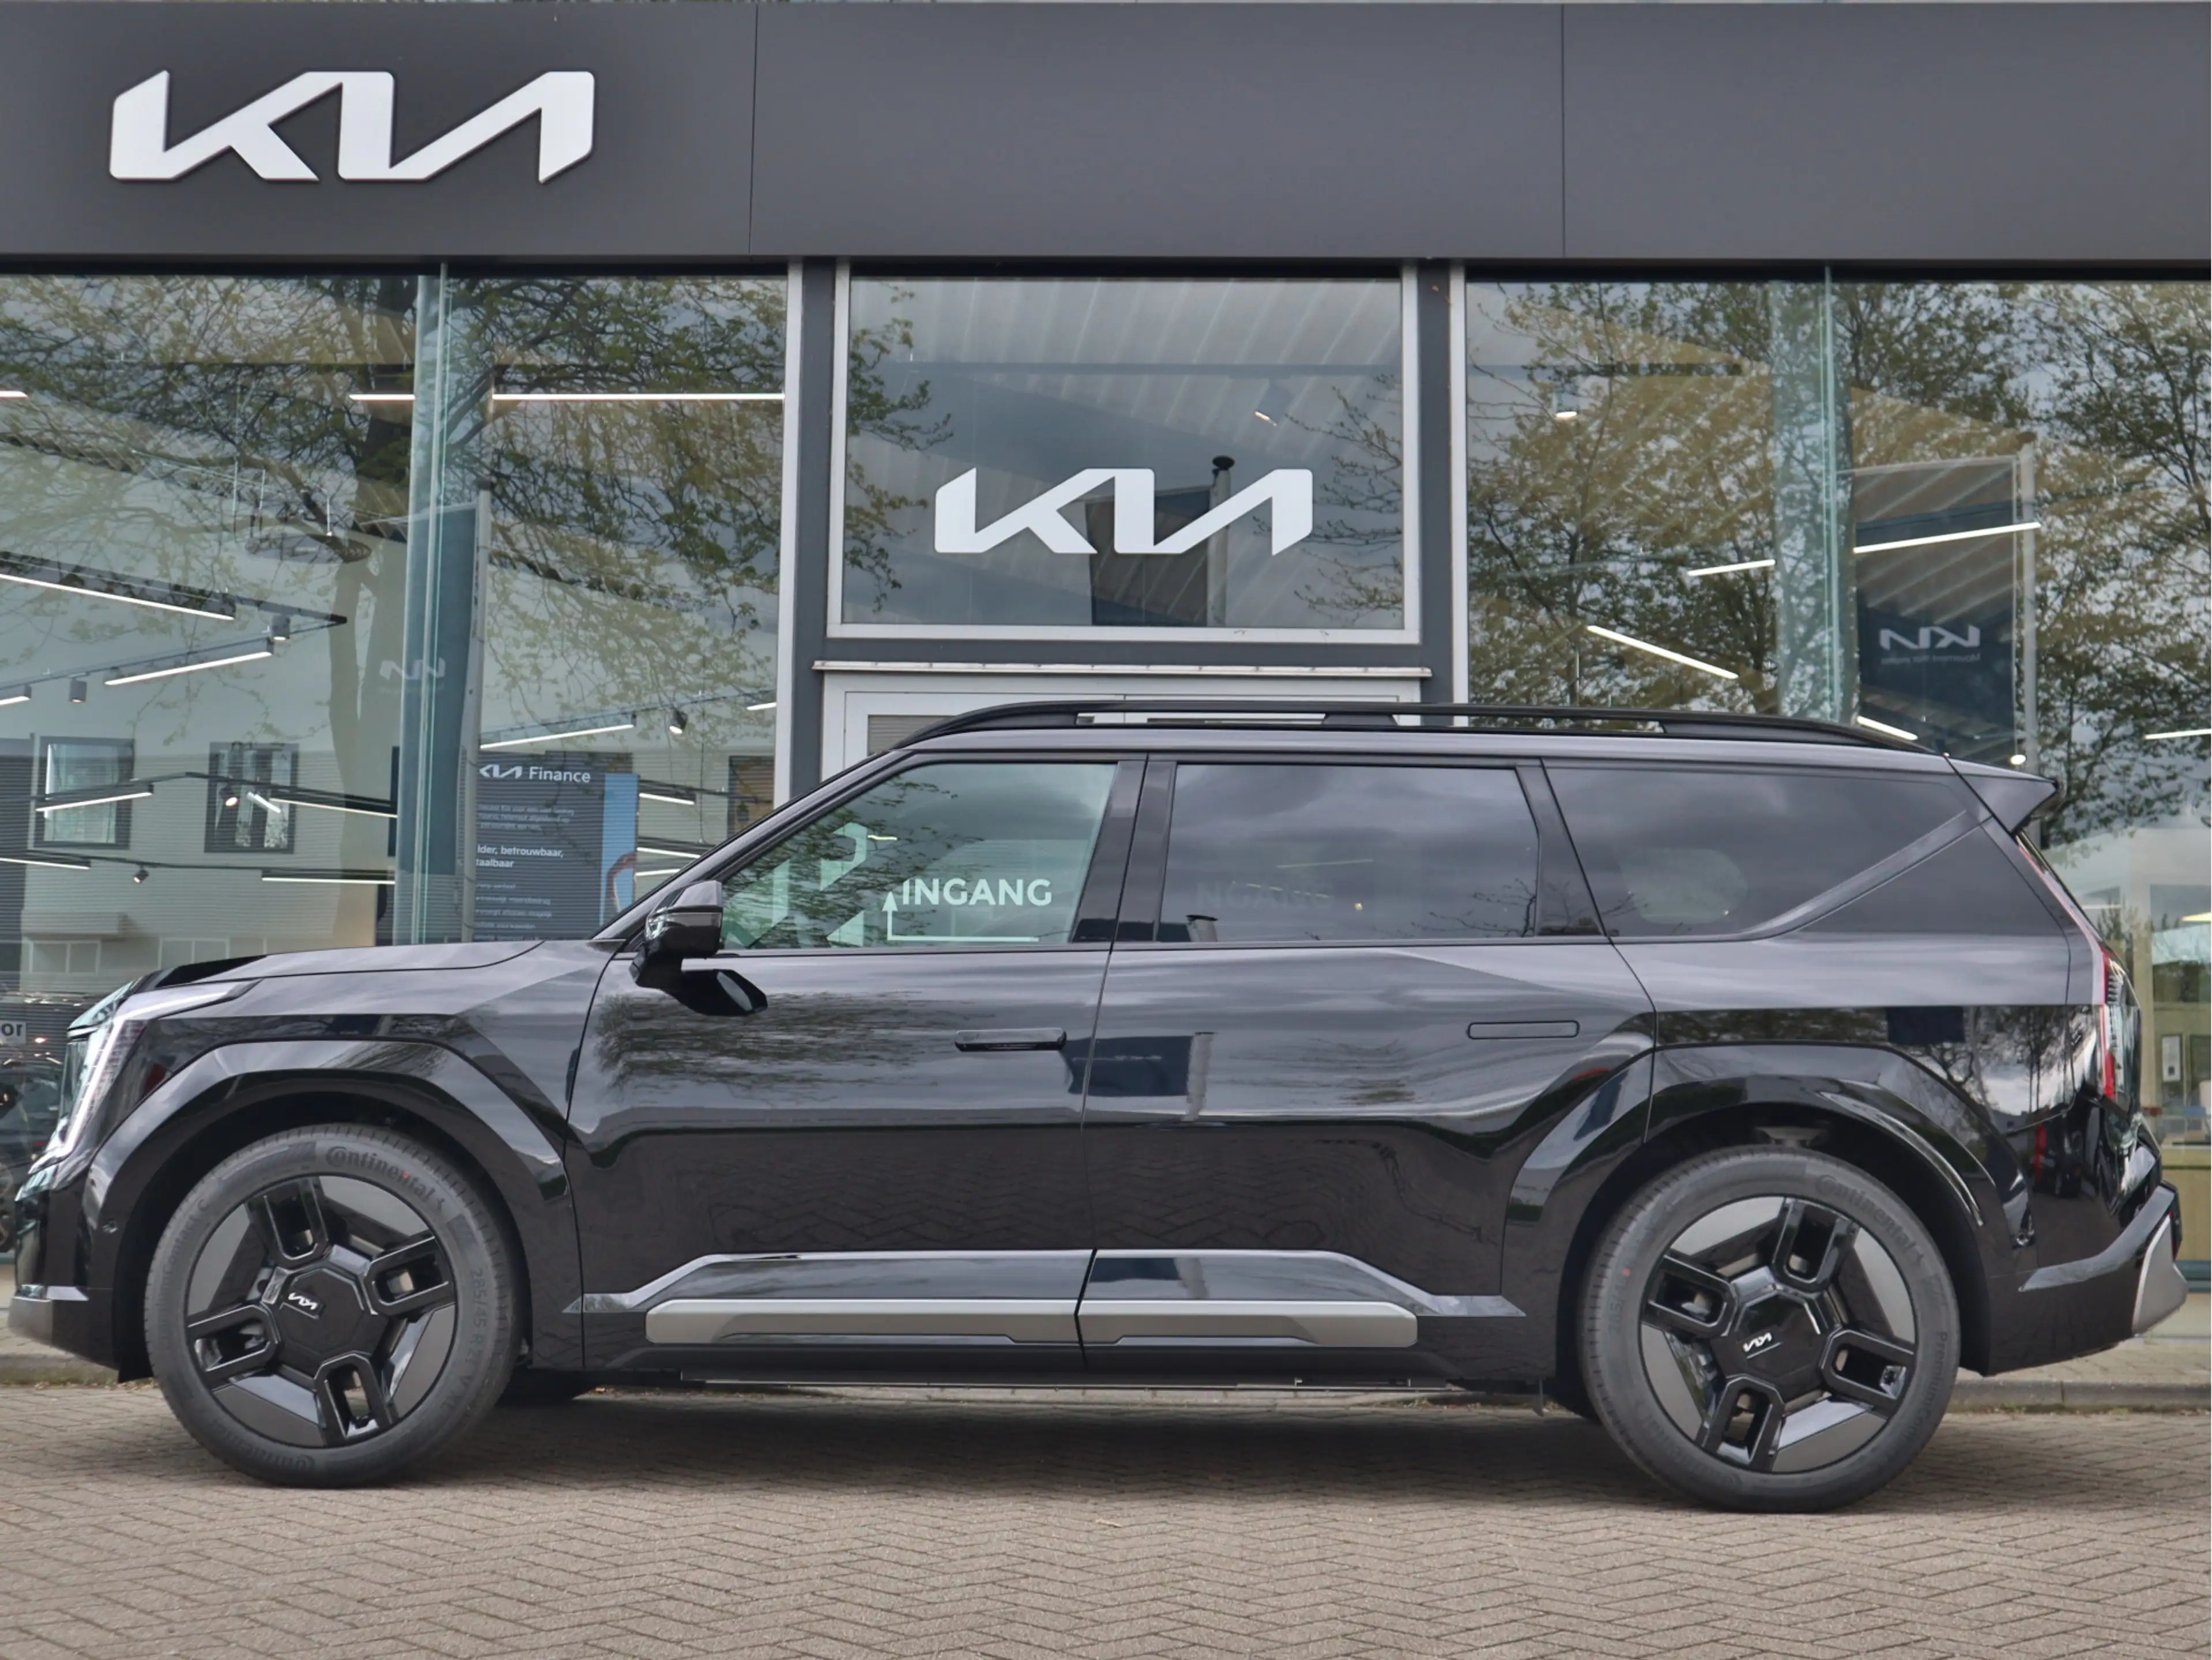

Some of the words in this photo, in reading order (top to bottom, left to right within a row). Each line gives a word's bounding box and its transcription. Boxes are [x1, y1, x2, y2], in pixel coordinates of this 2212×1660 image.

[110, 70, 595, 183] KIA
[934, 467, 1313, 556] KIA
[529, 766, 591, 783] Finance
[500, 846, 564, 858] betrouwbaar,
[902, 878, 1052, 906] INGANG
